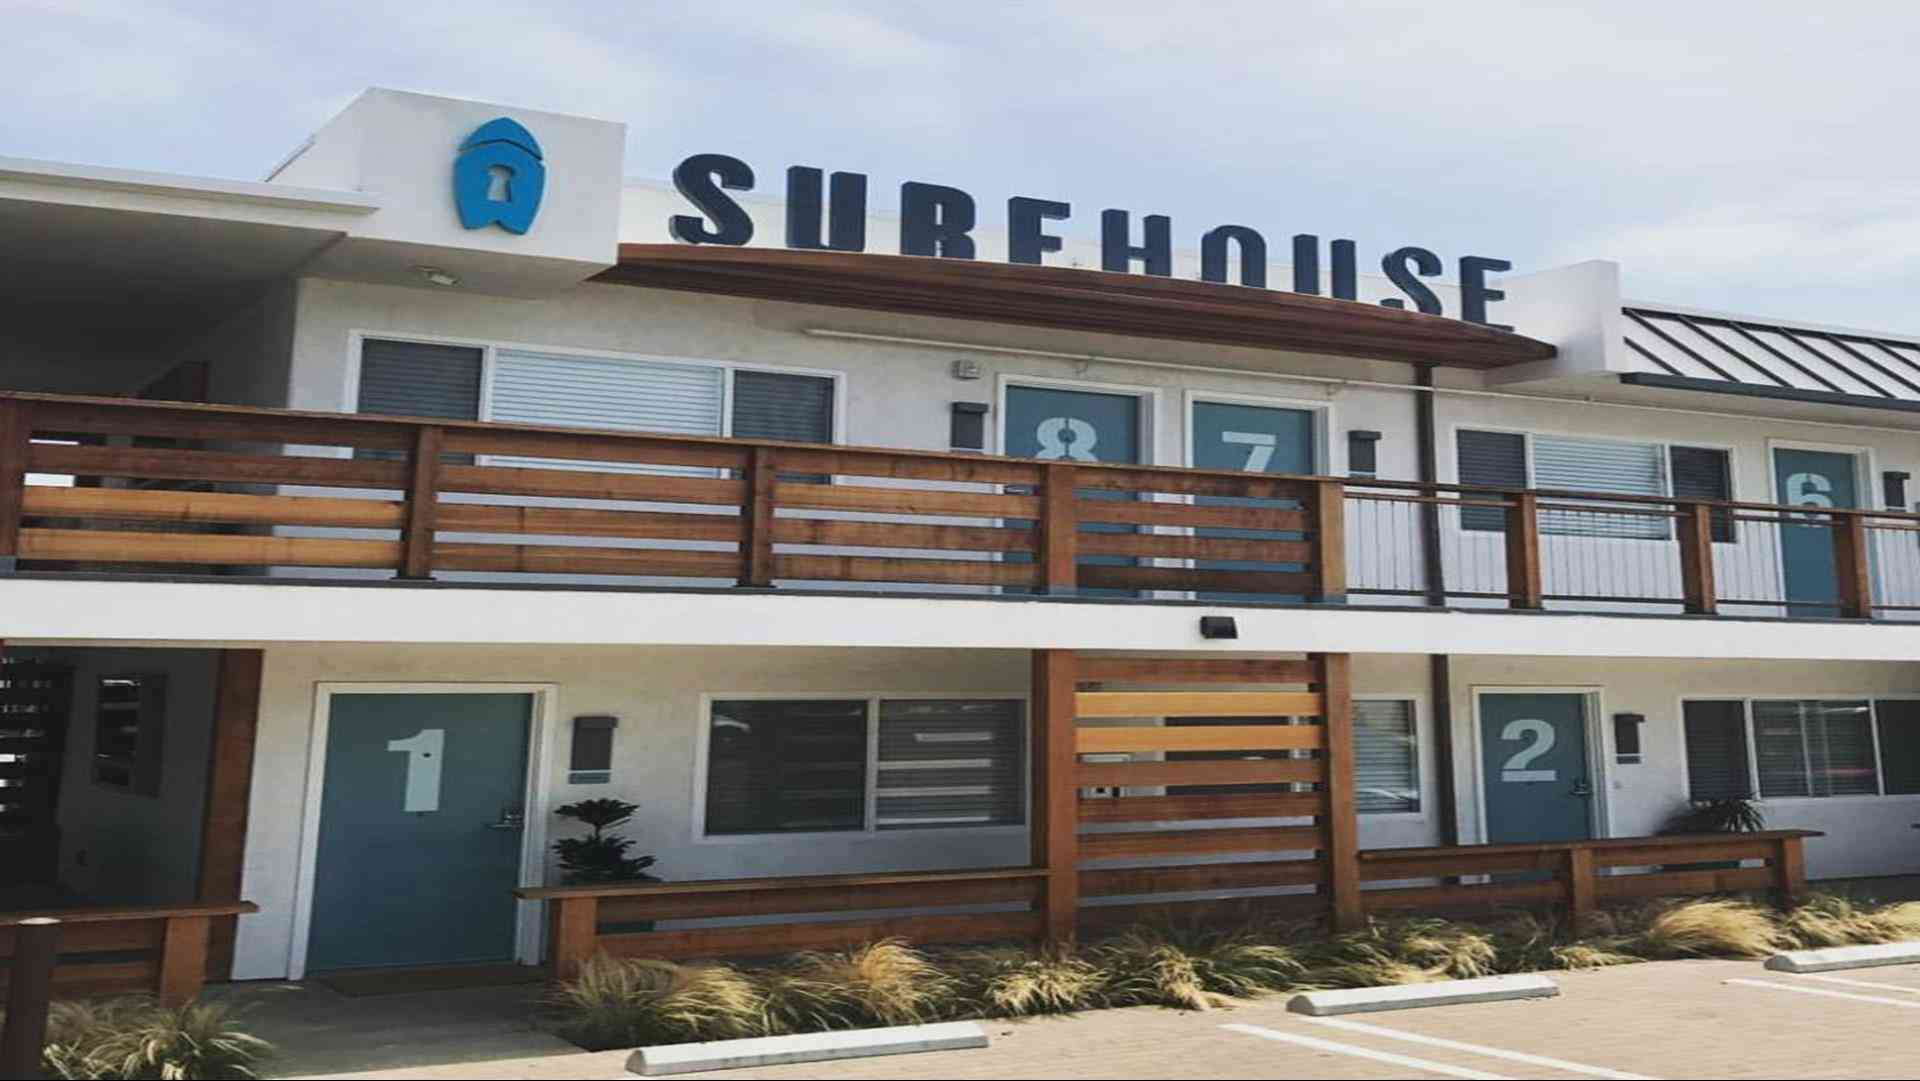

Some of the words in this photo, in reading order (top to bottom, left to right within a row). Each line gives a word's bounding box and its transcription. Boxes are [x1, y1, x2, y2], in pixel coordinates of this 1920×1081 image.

[669, 153, 1515, 332] SURFHOUSE
[1787, 473, 1833, 527] 6
[387, 729, 444, 812] 1
[1501, 719, 1557, 782] 2
